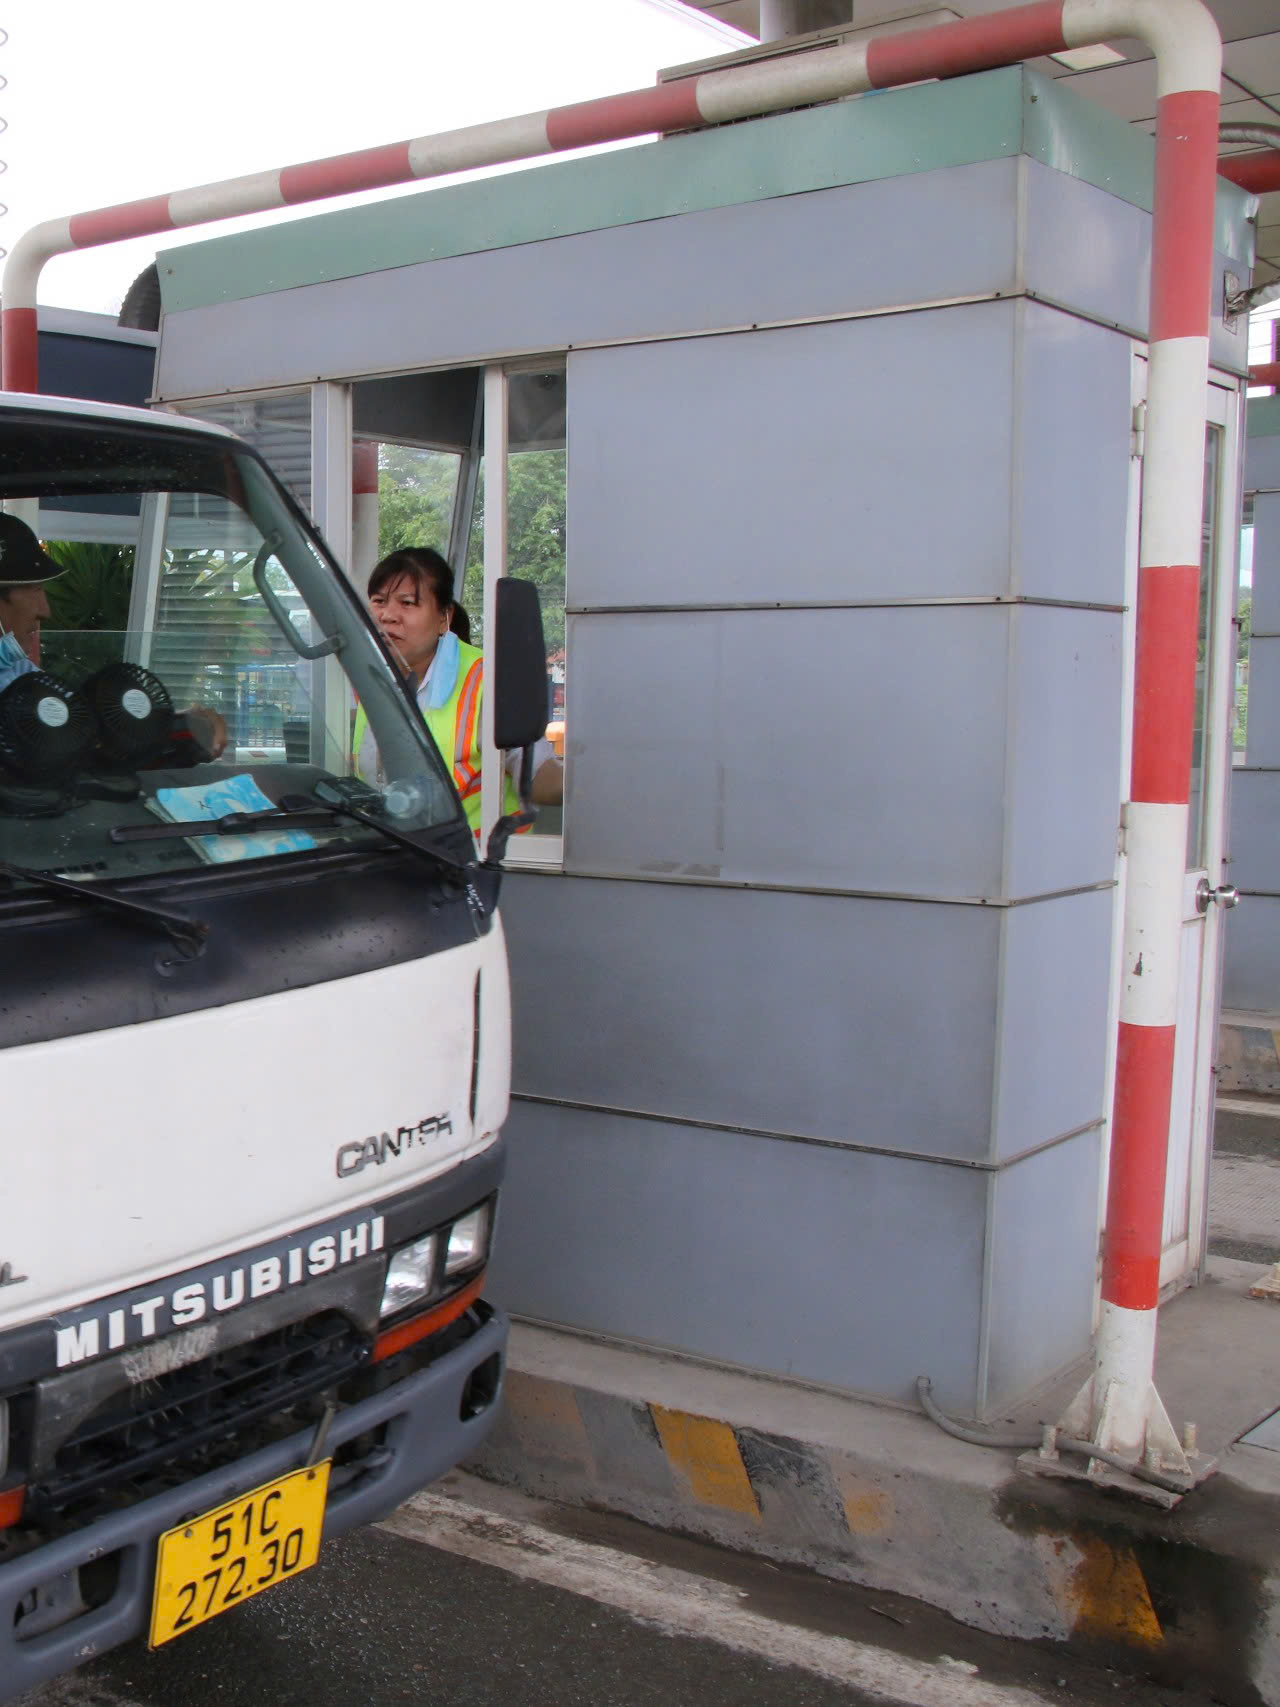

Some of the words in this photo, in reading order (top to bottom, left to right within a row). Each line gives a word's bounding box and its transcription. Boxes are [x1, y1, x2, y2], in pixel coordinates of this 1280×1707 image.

[56, 1215, 385, 1368] MITSUBISHI
[211, 1491, 281, 1561] 51C
[173, 1528, 304, 1630] 272.30
